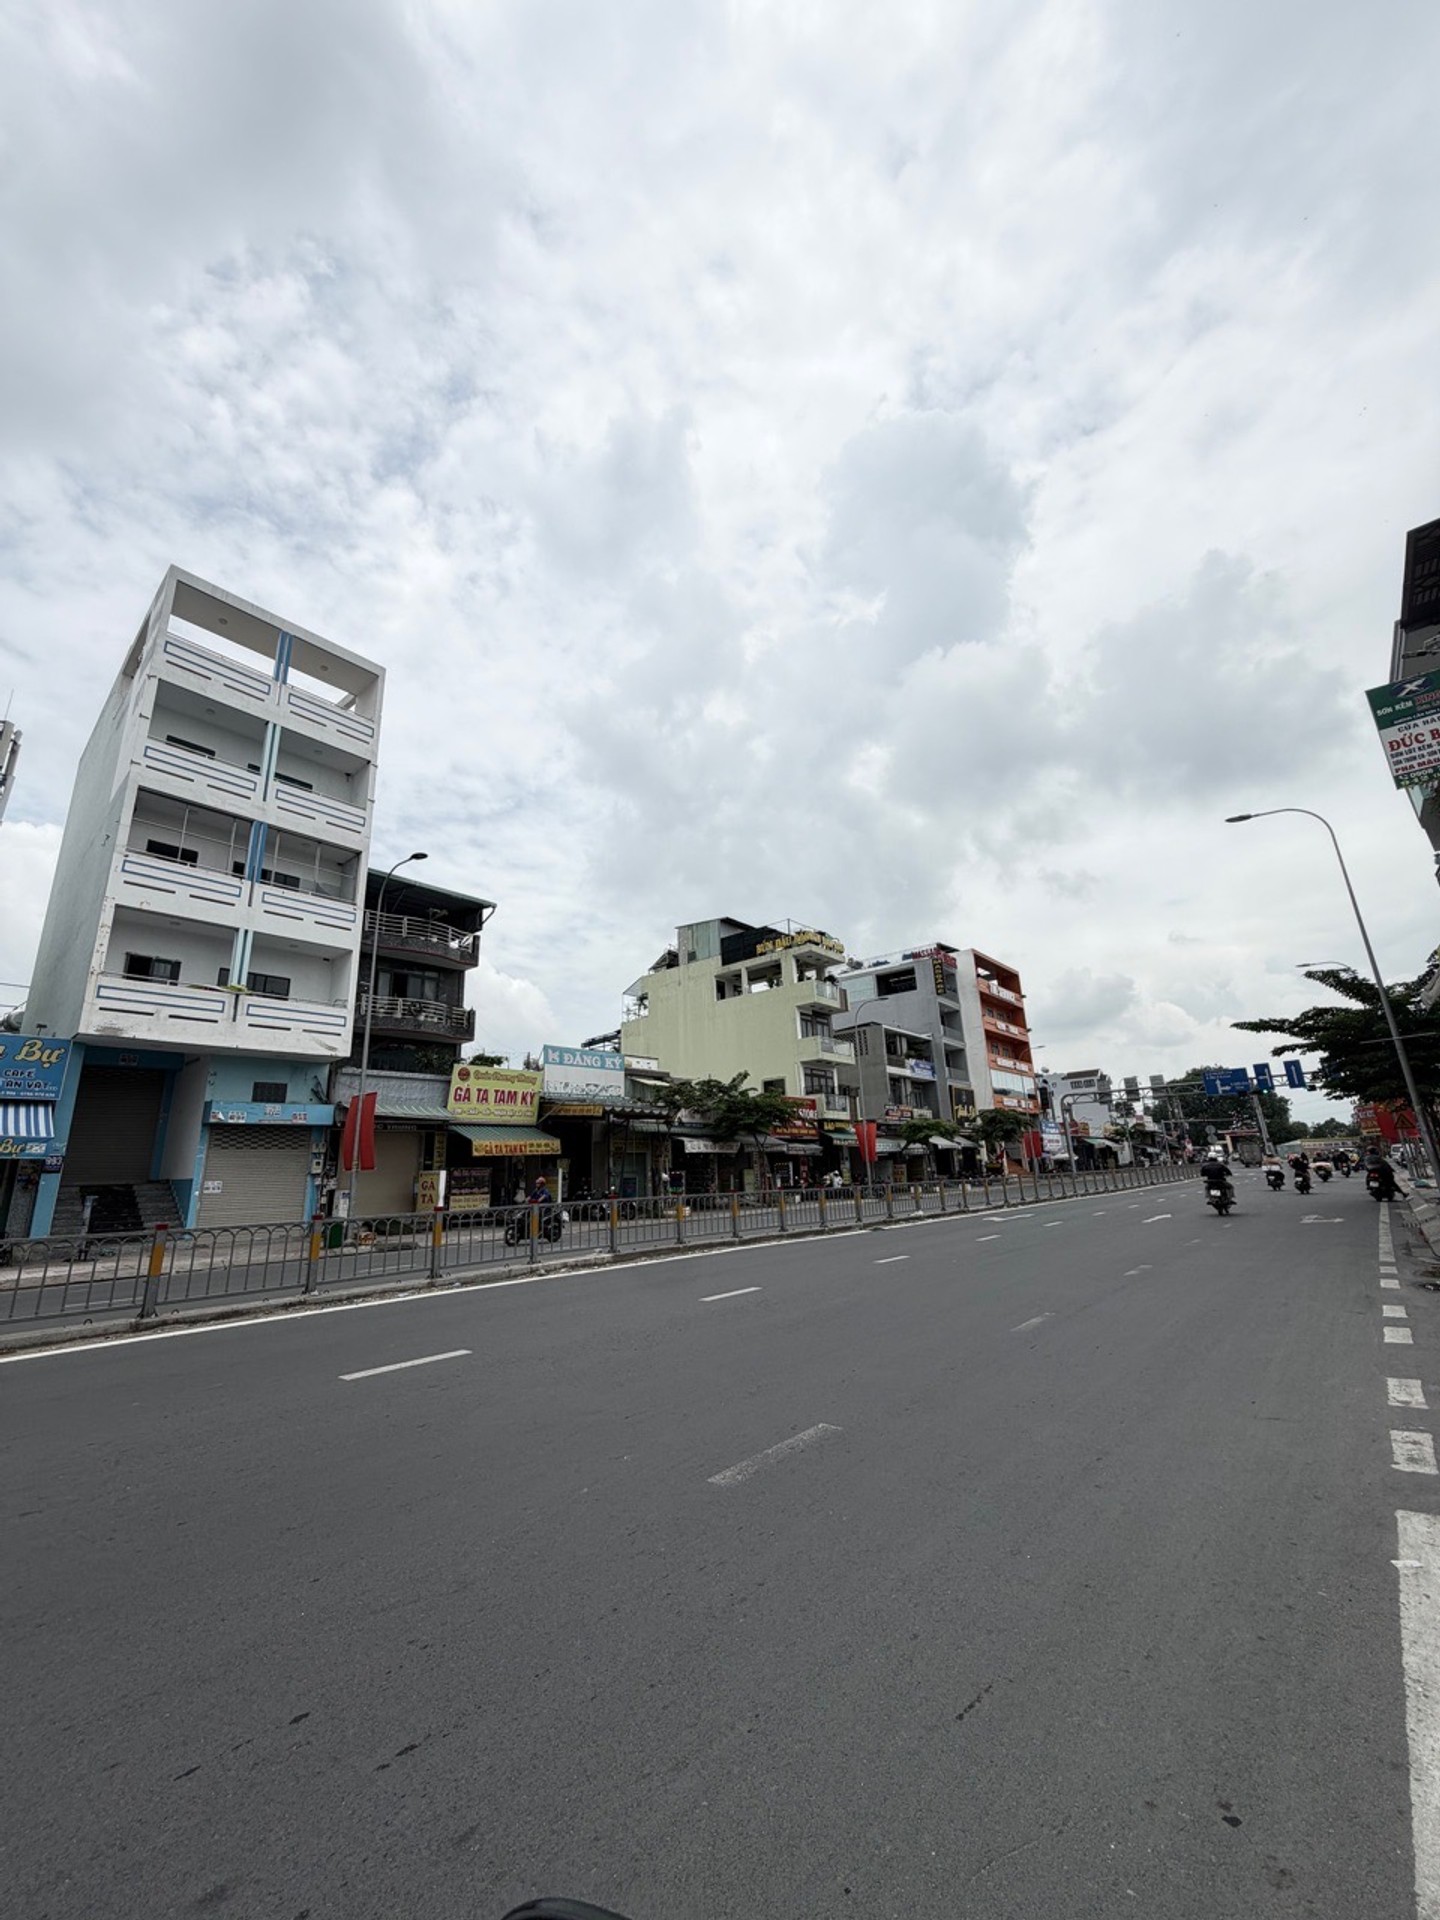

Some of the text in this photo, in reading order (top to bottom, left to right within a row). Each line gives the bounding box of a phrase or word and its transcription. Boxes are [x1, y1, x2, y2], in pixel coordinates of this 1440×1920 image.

[1388, 732, 1426, 752] ĐỨC
[14, 1039, 65, 1068] Bự
[563, 1051, 601, 1067] ĐĂNG
[454, 1084, 471, 1102] GÀ
[476, 1088, 488, 1104] TA
[493, 1089, 517, 1105] TAM
[798, 1109, 818, 1120] STORE
[421, 1178, 435, 1191] GÀ
[421, 1194, 434, 1204] TA
